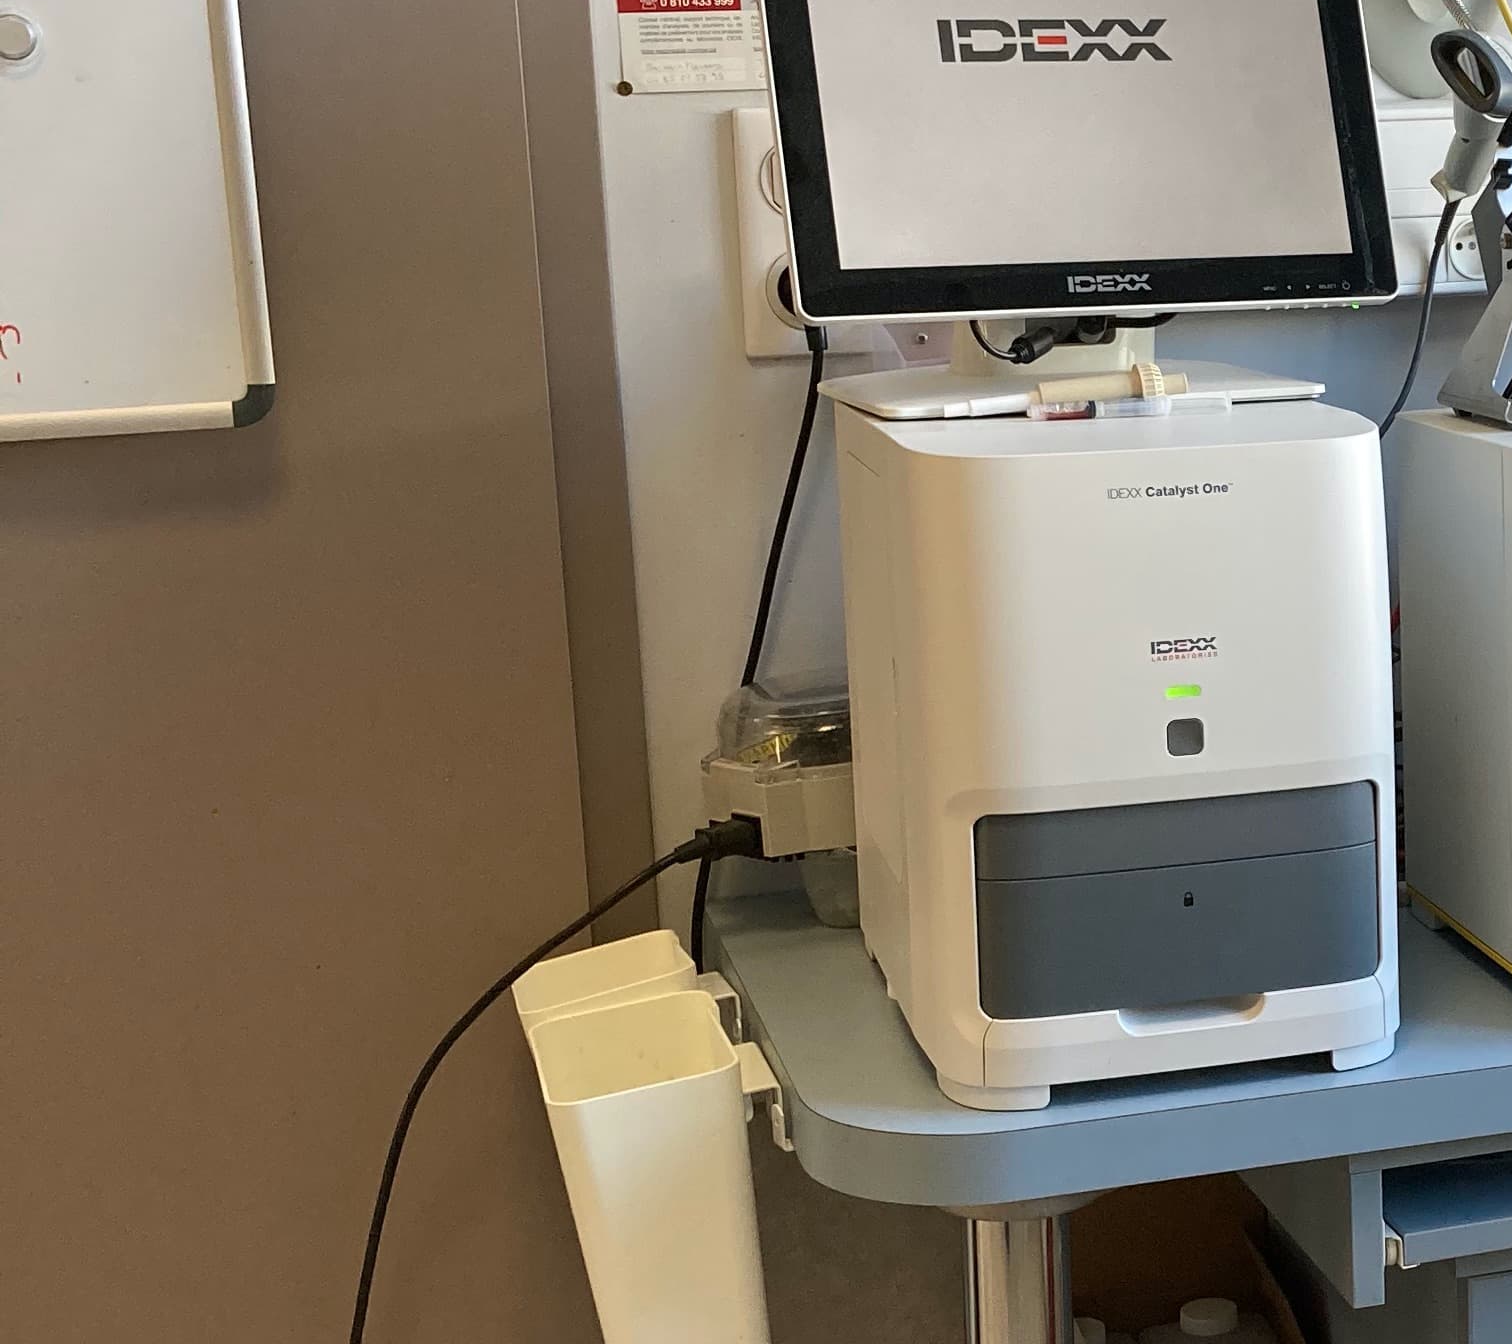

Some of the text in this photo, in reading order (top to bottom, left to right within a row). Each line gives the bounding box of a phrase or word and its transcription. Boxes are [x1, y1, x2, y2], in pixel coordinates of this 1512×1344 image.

[936, 18, 1173, 63] IDEXX
[1066, 273, 1153, 294] IDEXX
[1106, 487, 1143, 500] IDEXX
[1145, 484, 1200, 499] Catalyst
[1151, 636, 1218, 655] IDEXX
[1151, 651, 1219, 663] LABORATORIES
